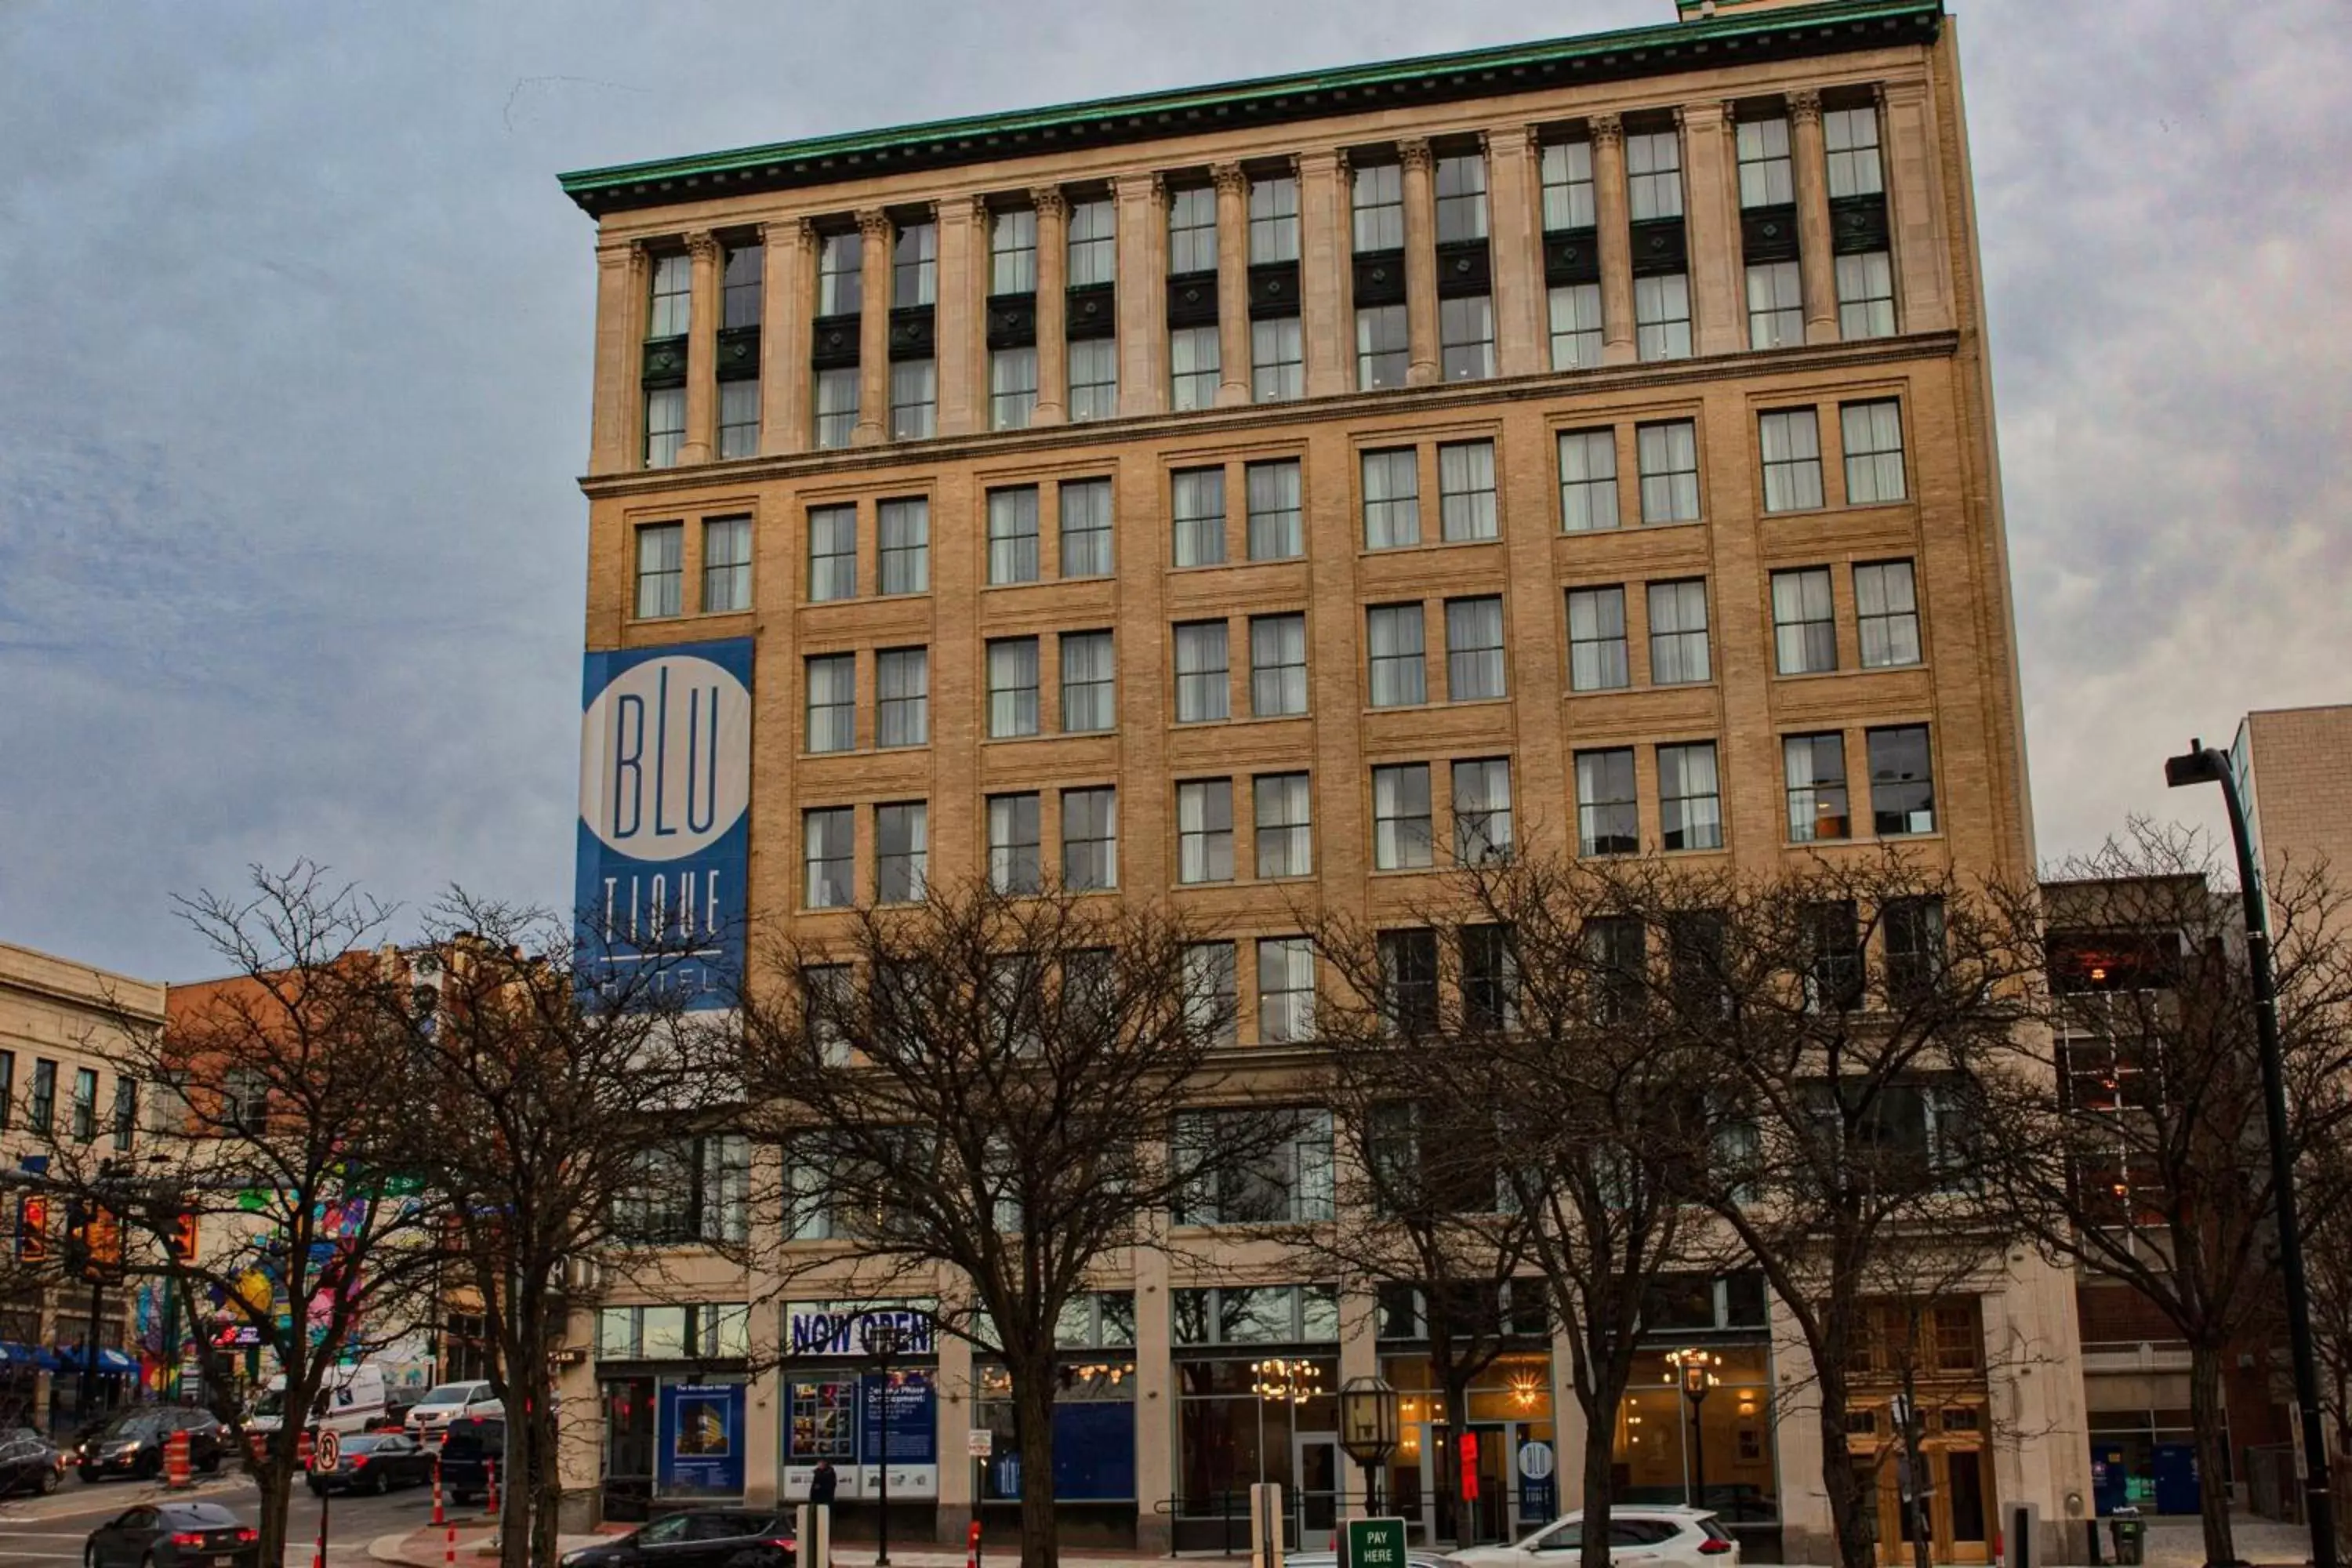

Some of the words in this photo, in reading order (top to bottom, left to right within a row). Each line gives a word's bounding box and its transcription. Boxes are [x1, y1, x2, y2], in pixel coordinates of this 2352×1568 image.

[614, 666, 718, 839] BLU
[604, 869, 720, 944] TIQUE
[793, 1313, 851, 1354] NOW
[861, 1312, 927, 1354] OPEN
[1364, 1548, 1393, 1563] HERE
[1367, 1531, 1388, 1544] PAY
